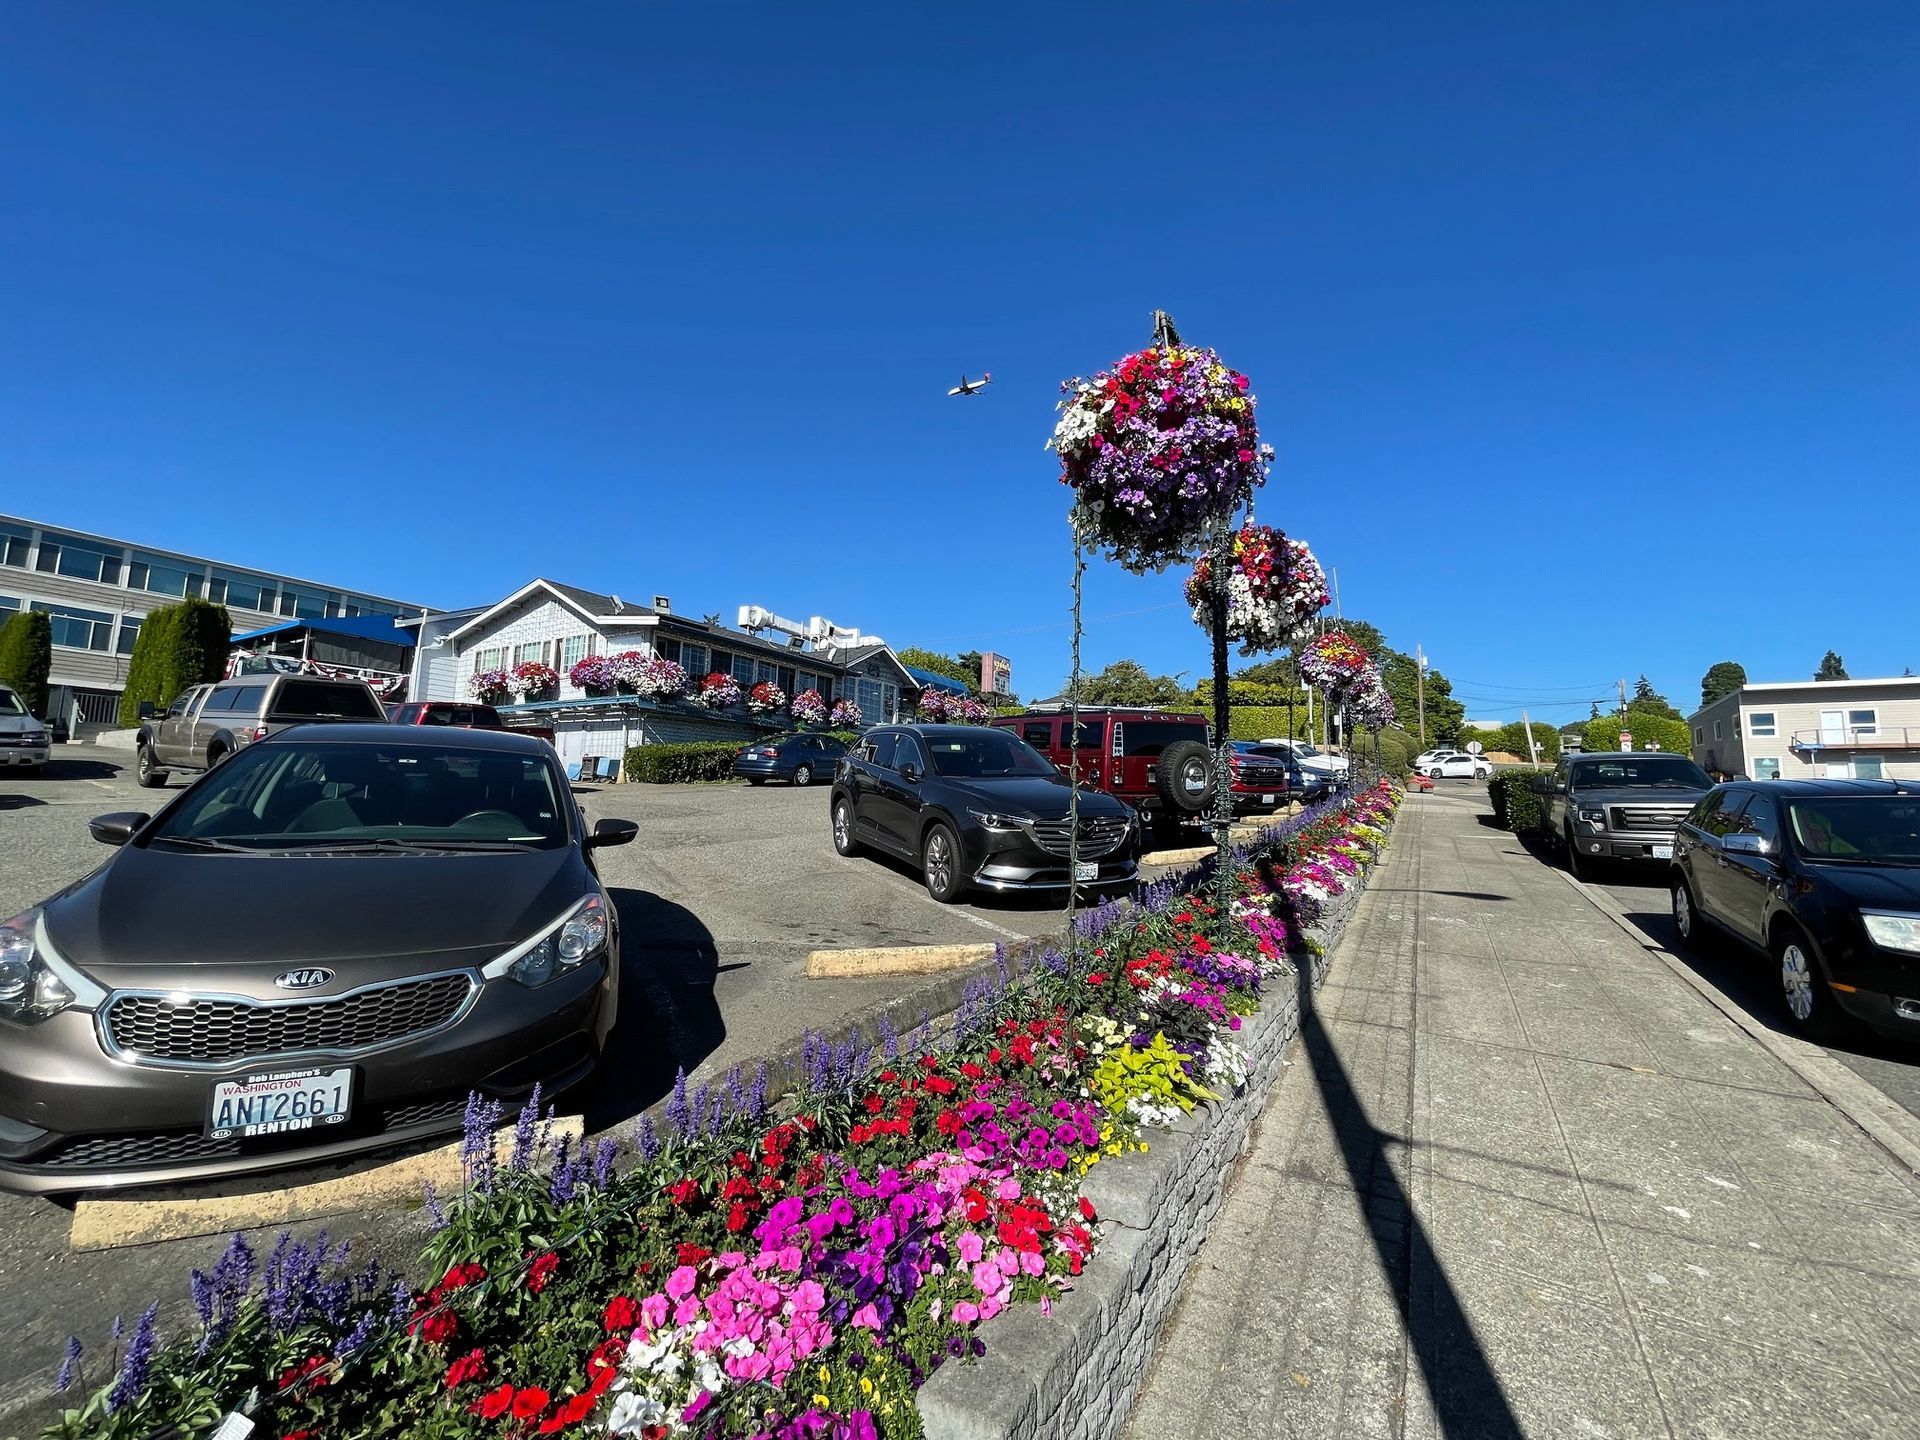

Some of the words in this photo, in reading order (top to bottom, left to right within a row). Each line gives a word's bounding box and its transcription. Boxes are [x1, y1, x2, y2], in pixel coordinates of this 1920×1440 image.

[284, 970, 324, 985] KIA
[248, 1074, 269, 1084] Bob
[223, 1080, 302, 1096] WASHINGTON
[217, 1086, 341, 1128] ANT2661
[245, 1117, 313, 1137] RENTON
